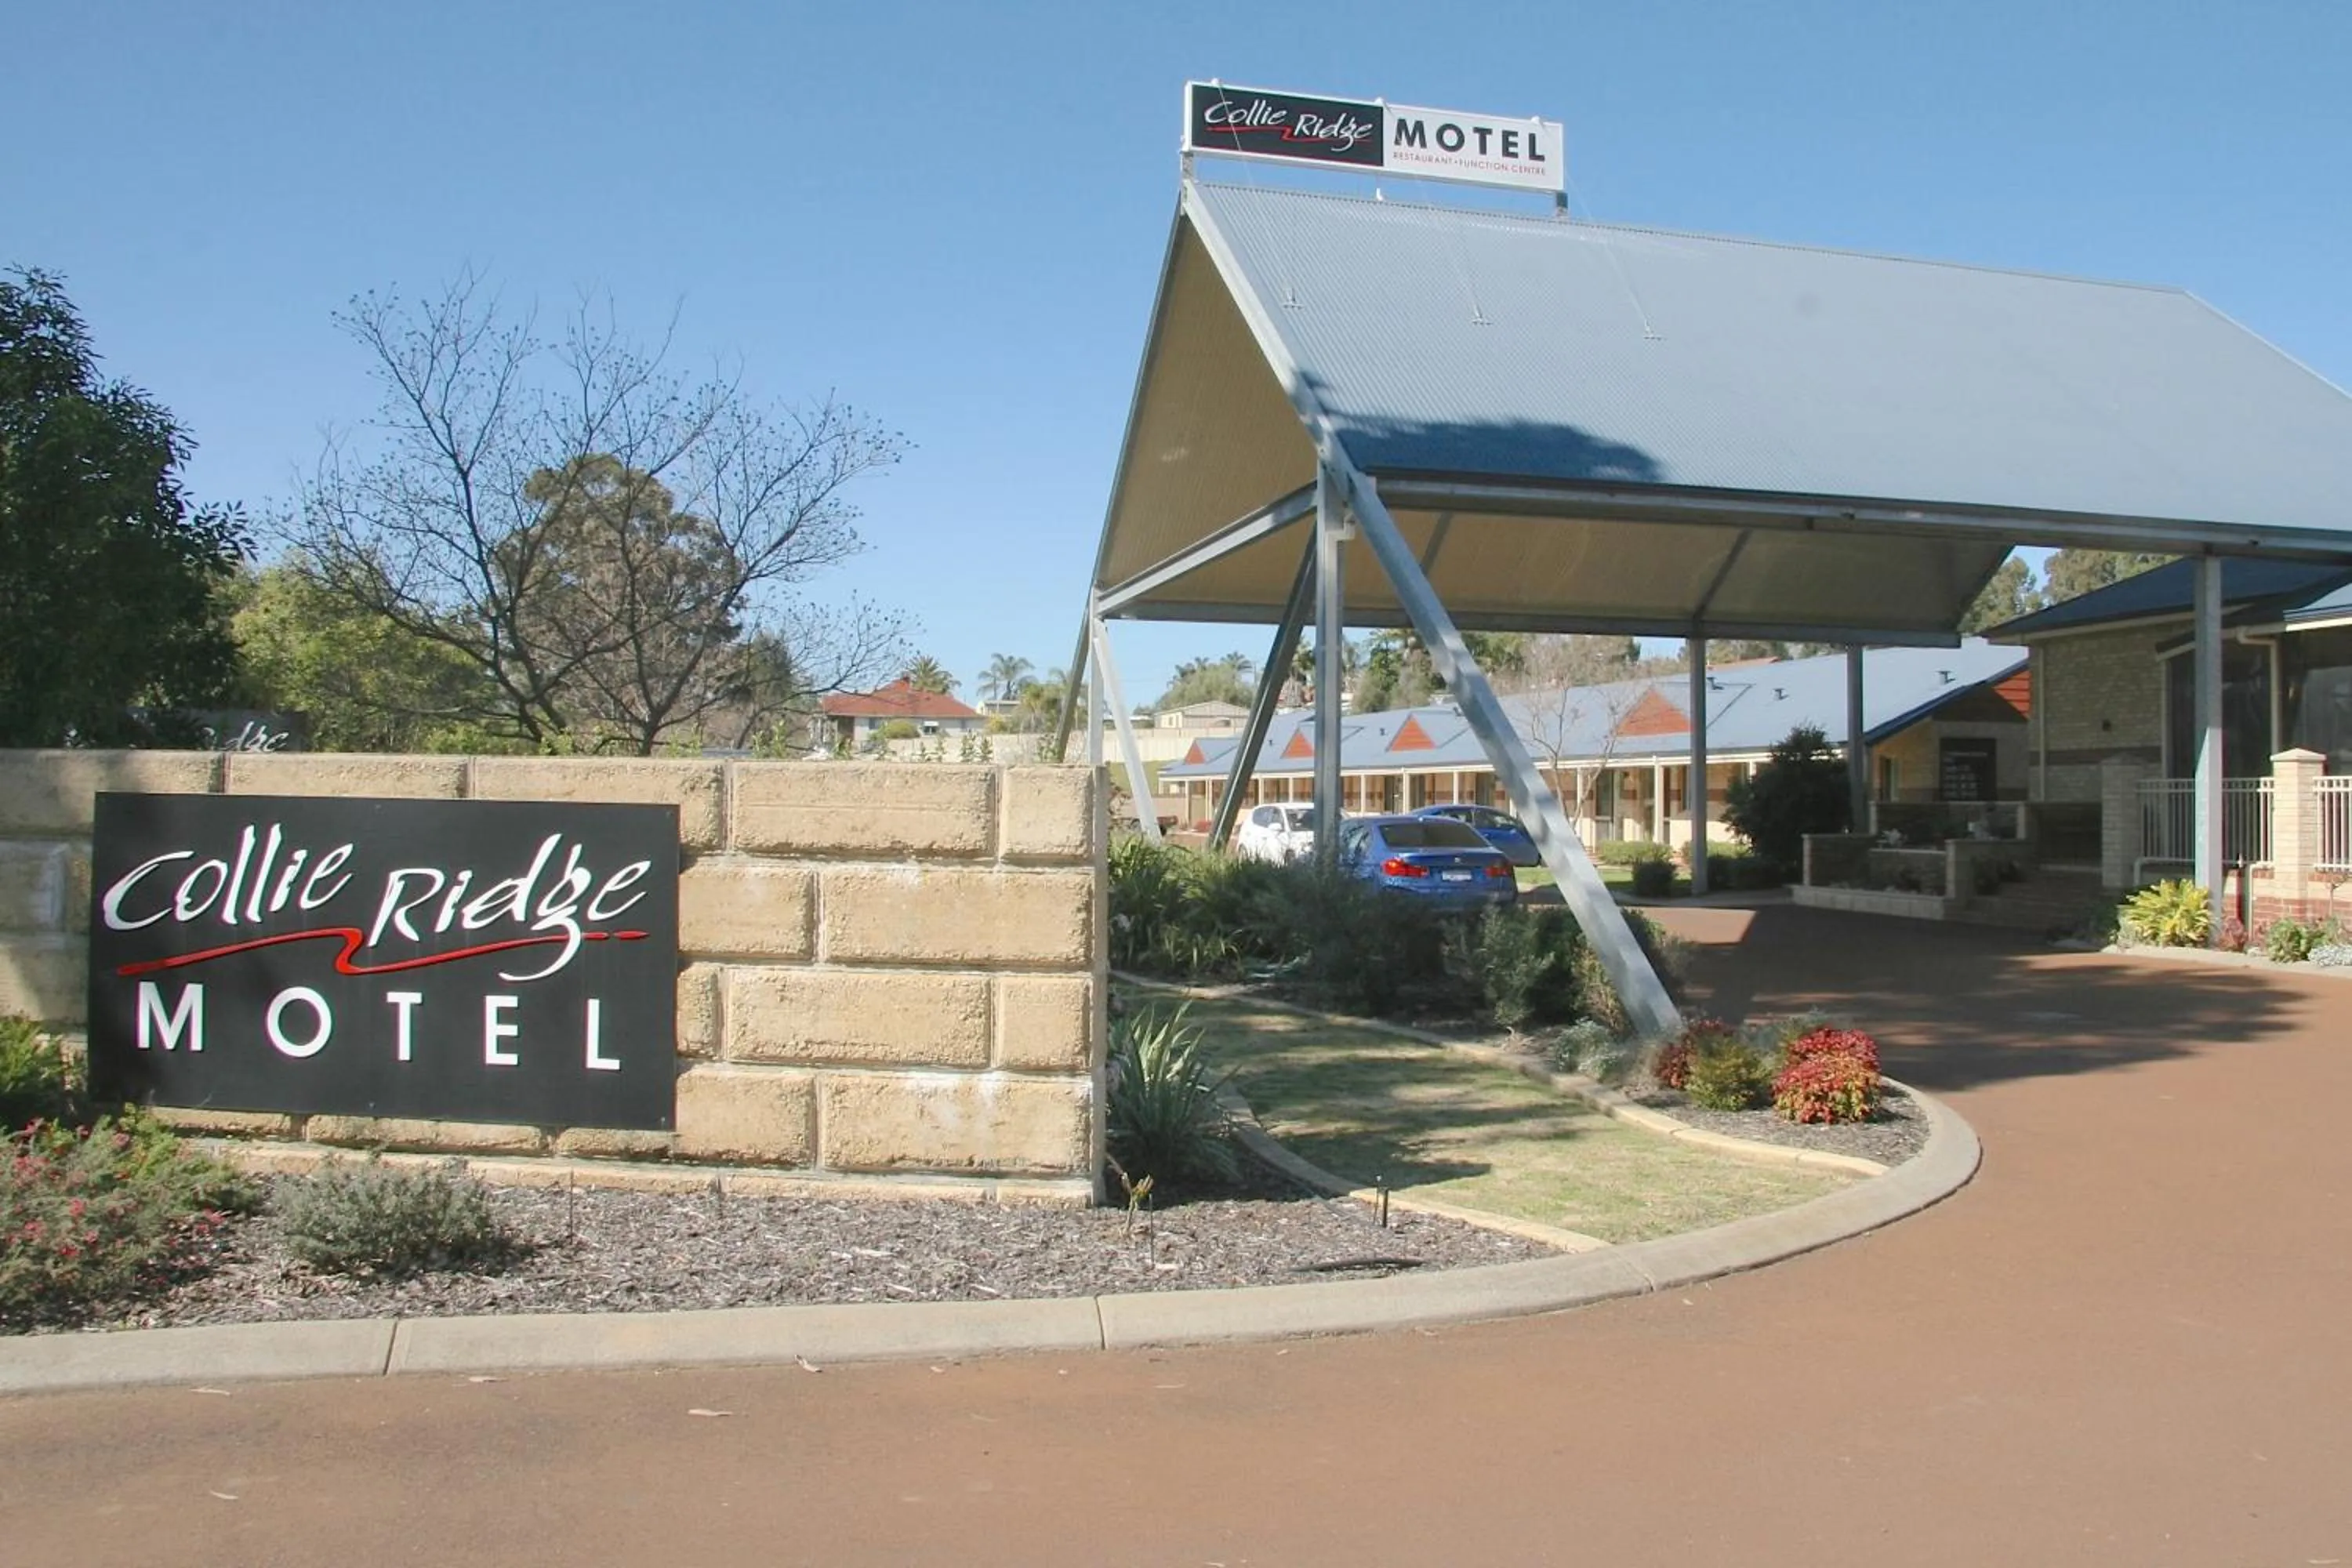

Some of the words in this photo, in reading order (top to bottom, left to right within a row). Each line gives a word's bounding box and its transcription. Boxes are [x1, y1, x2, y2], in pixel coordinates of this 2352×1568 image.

[1203, 99, 1287, 127] Collie
[1293, 111, 1375, 152] Ridge
[1393, 118, 1546, 162] MOTEL
[1511, 164, 1546, 176] CENTRE
[102, 822, 354, 931] Collie
[368, 833, 652, 982] Ridge
[136, 980, 622, 1072] MOTEL
